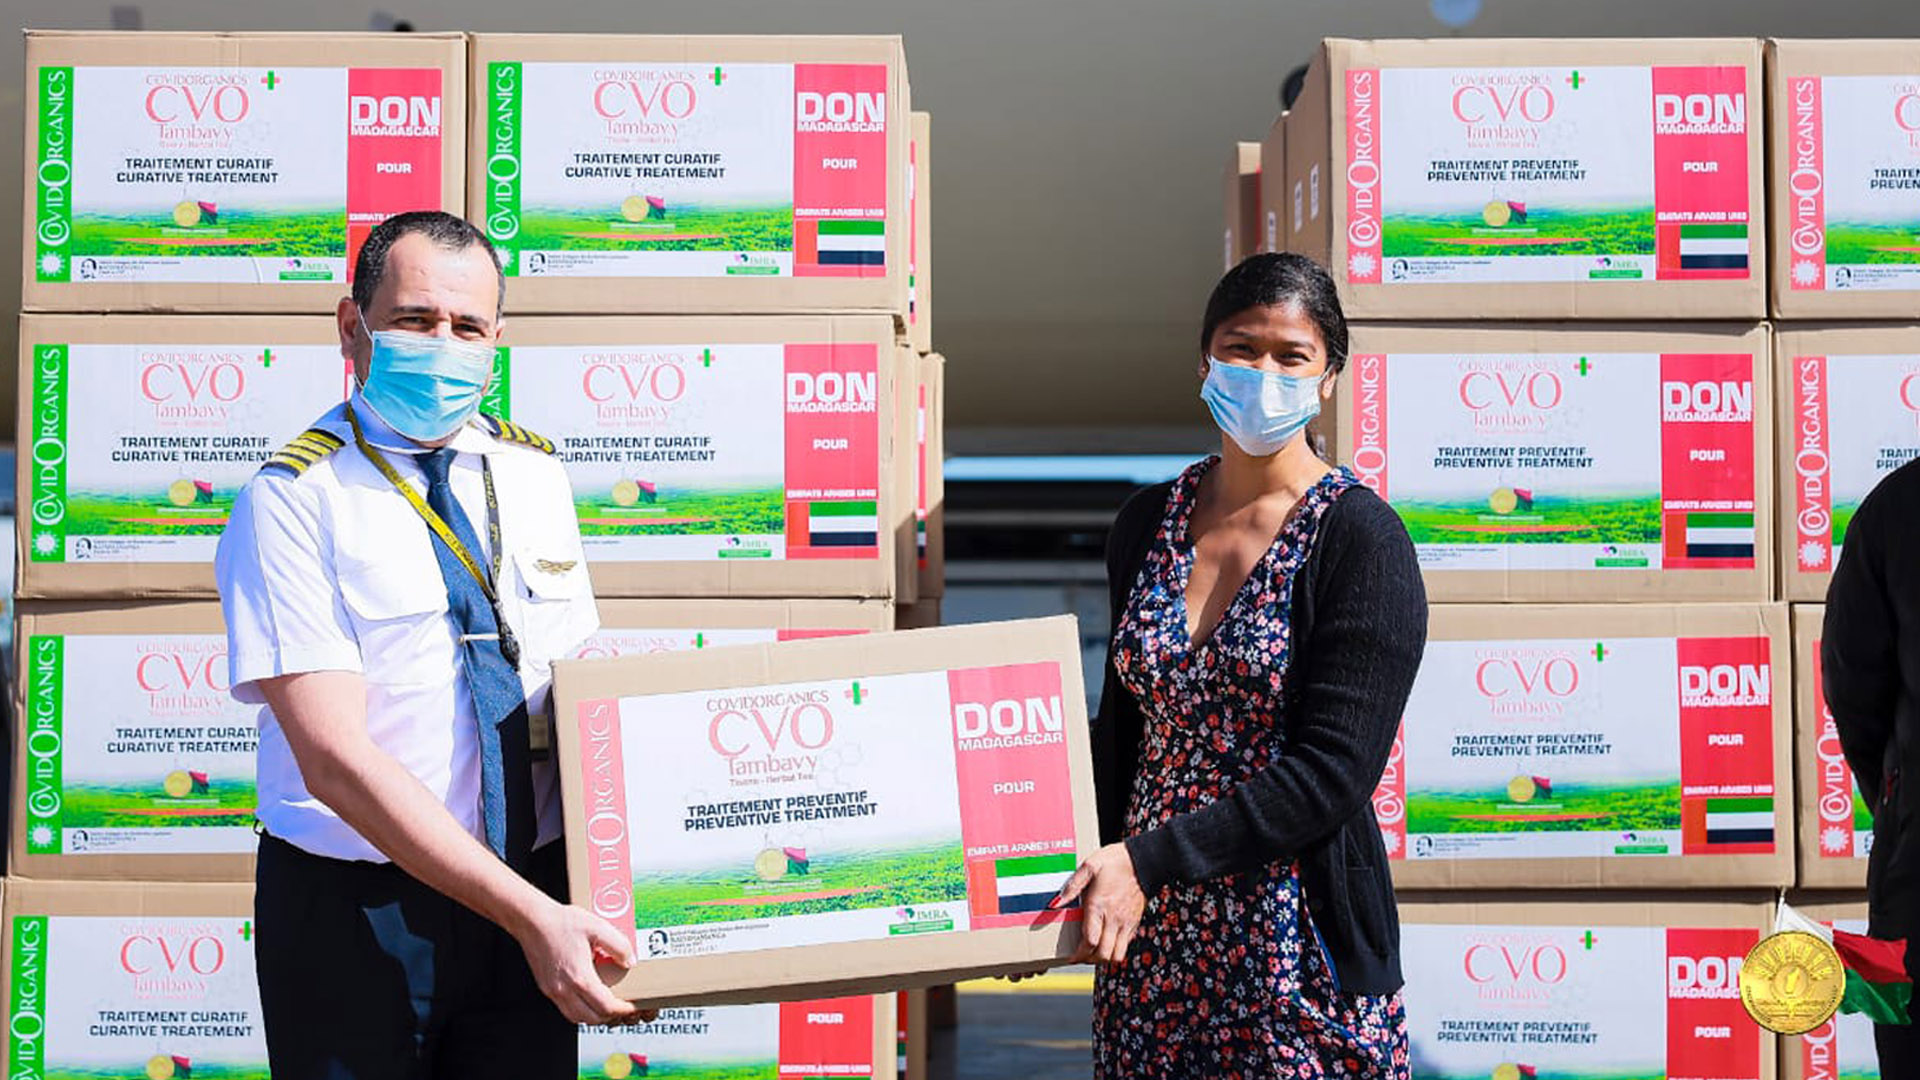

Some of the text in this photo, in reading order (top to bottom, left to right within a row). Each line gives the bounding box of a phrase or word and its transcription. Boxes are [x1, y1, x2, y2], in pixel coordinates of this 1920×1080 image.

[145, 85, 249, 123] CVO
[594, 81, 697, 119] CVO
[1452, 85, 1554, 122] CVO
[350, 96, 440, 126] DON
[797, 92, 885, 122] DON
[1655, 94, 1745, 124] DON
[159, 123, 232, 141] Tambavy
[351, 125, 440, 137] MADAGASCAR
[606, 119, 678, 137] Tambavy
[797, 121, 884, 133] MADAGASCAR
[1466, 124, 1541, 141] Tambavy
[1656, 123, 1745, 135] MADAGASCAR
[125, 158, 274, 170] TRAITEMENT CURATIF
[574, 153, 721, 165] TRAITEMENT CURATIF
[822, 157, 857, 170] POUR
[1430, 159, 1580, 171] TRAITEMENT PREVENTIF
[376, 162, 412, 174] POUR
[565, 167, 725, 179] CURATIVE TREATEMENT
[1683, 161, 1718, 173] POUR
[116, 171, 279, 183] CURATIVE TREATEMENT
[1427, 170, 1586, 182] PREVENTIVE TREATMENT
[142, 363, 244, 401] CVO
[583, 363, 686, 402] CVO
[787, 372, 876, 402] DON
[1460, 371, 1562, 409] CVO
[1663, 381, 1752, 412] DON
[154, 402, 228, 419] Tambavy
[597, 402, 670, 419] Tambavy
[787, 401, 876, 413] MADAGASCAR
[1663, 411, 1752, 422] MADAGASCAR
[1354, 357, 1386, 494] DORGANICS
[120, 437, 270, 449] TRAITEMENT CURATIF
[563, 436, 711, 449] TRAITEMENT CURATIF
[813, 439, 848, 450] POUR
[111, 450, 274, 462] CURATIVE TREATEMENT
[556, 450, 716, 463] CURATIVE TREATEMENT
[1438, 446, 1587, 458] TRAITEMENT PREVENTIF
[1690, 449, 1725, 462] POUR
[1434, 457, 1594, 469] PREVENTIVE TREATMENT
[1476, 658, 1579, 697] CVO
[1680, 664, 1770, 695] DON
[706, 689, 830, 713] COVIDORGANICS
[1681, 694, 1770, 707] MADAGASCAR
[954, 696, 1064, 739] DON
[116, 728, 203, 739] TRAITEMENT
[708, 703, 833, 756] CVO
[958, 731, 1064, 751] MADAGASCAR
[1455, 733, 1605, 746] TRAITEMENT PREVENTIF
[1708, 734, 1744, 746] POUR
[107, 742, 259, 753] CURATIVE TREATEMEN
[1451, 744, 1613, 757] PREVENTIVE TREATMENT
[724, 753, 818, 776] Tambavy
[993, 780, 1035, 795] POUR
[687, 790, 868, 818] TRAITEMENT PREVENTIF
[587, 703, 631, 919] COVIDORGANICS
[685, 803, 878, 832] PREVENTIVE TREATMENT
[967, 844, 1009, 857] EMIRATS
[120, 935, 224, 975] CVO
[1464, 944, 1567, 983] CVO
[1669, 987, 1741, 999] MADAGASC
[98, 1011, 248, 1023] TRAITEMENT CURATIF
[658, 1009, 705, 1021] URATIF
[807, 1012, 843, 1024] POUR
[90, 1025, 253, 1037] CURATIVE TREATEMENT
[618, 1023, 710, 1035] TREATEMENT
[1441, 1021, 1592, 1032] TRAITEMENT PREVENTIF
[1694, 1026, 1731, 1037] POUR
[1437, 1032, 1598, 1044] PREVENTIVE TREATMENT
